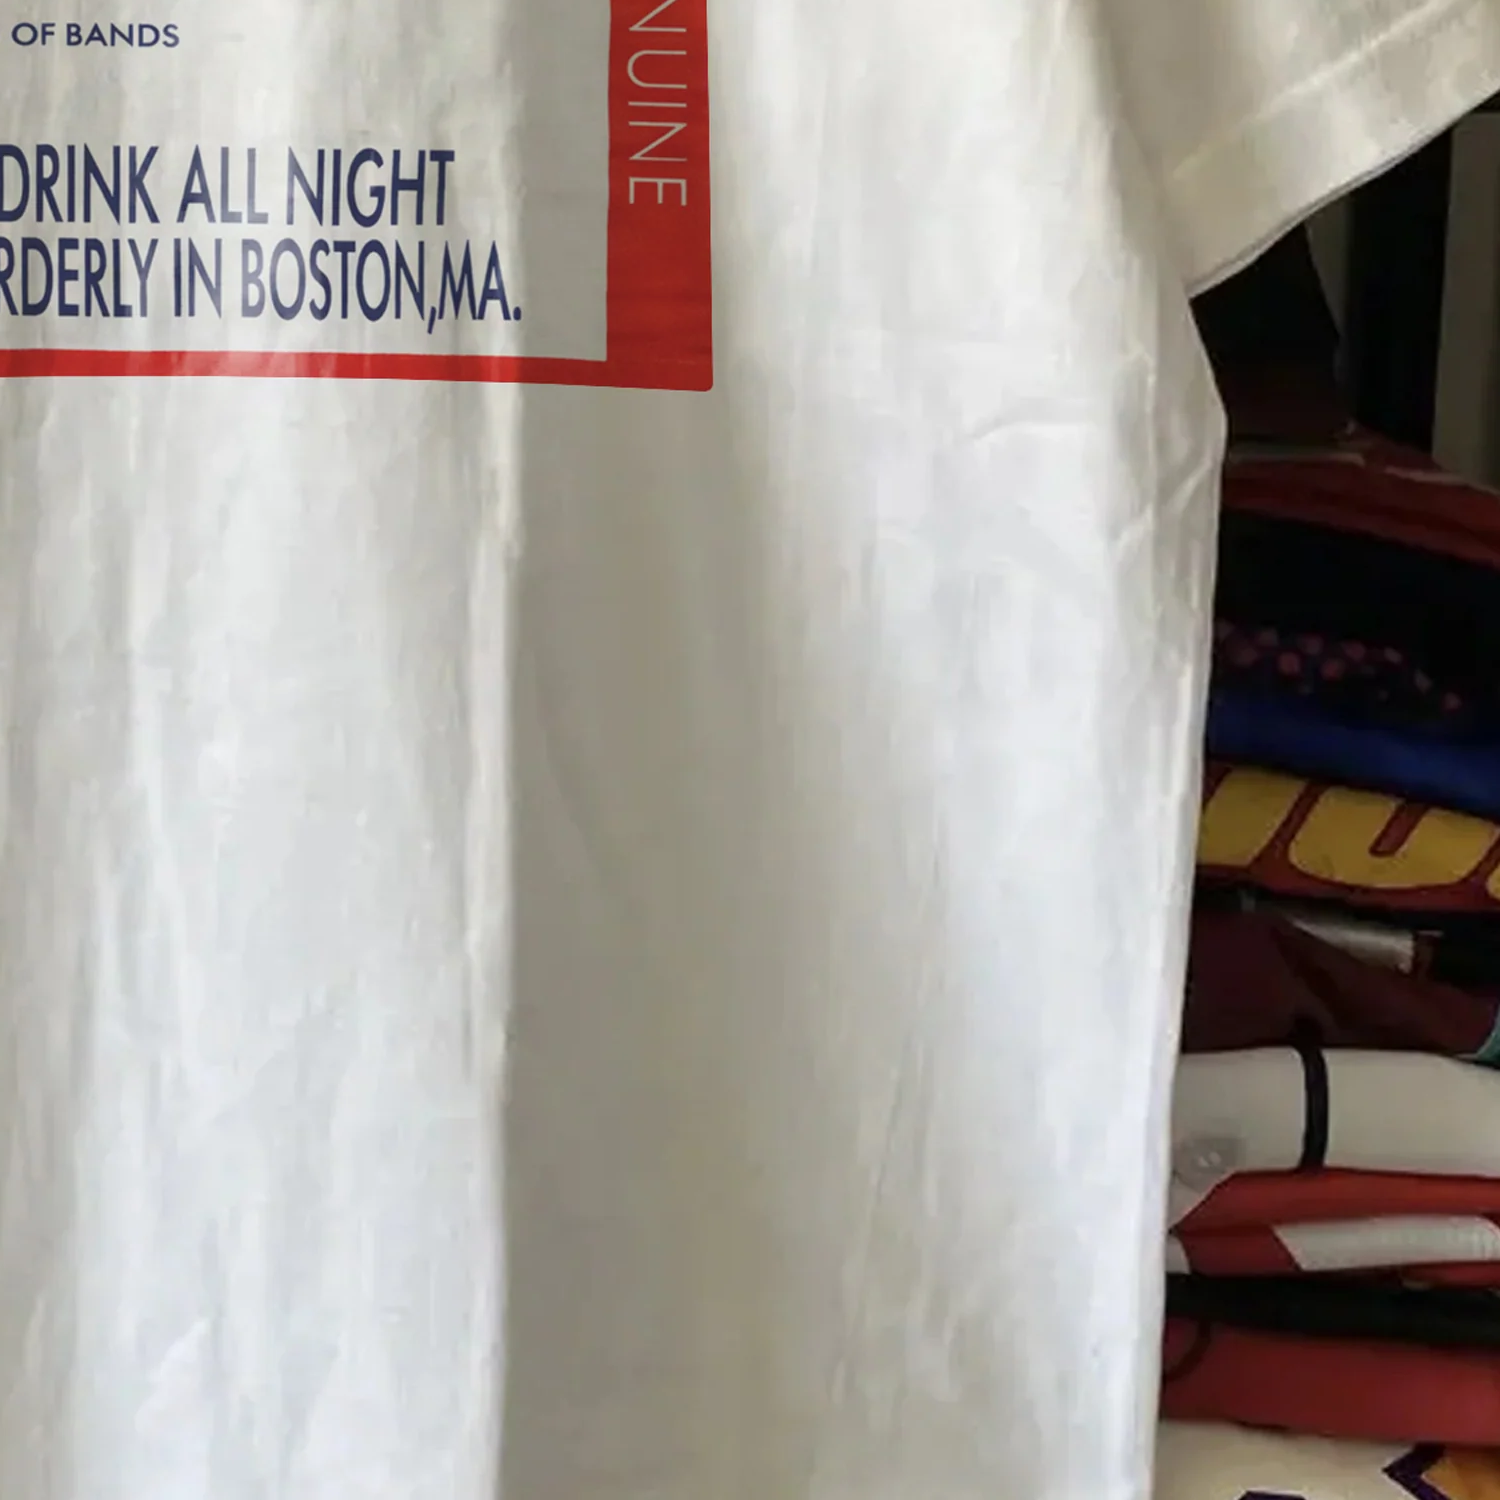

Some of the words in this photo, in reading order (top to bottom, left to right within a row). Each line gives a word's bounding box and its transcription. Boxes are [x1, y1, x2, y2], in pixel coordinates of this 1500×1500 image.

[11, 22, 56, 48] OF
[66, 22, 181, 49] BANDS
[175, 145, 269, 225] ALL
[286, 146, 455, 228] NIGHT
[172, 237, 223, 318] IN
